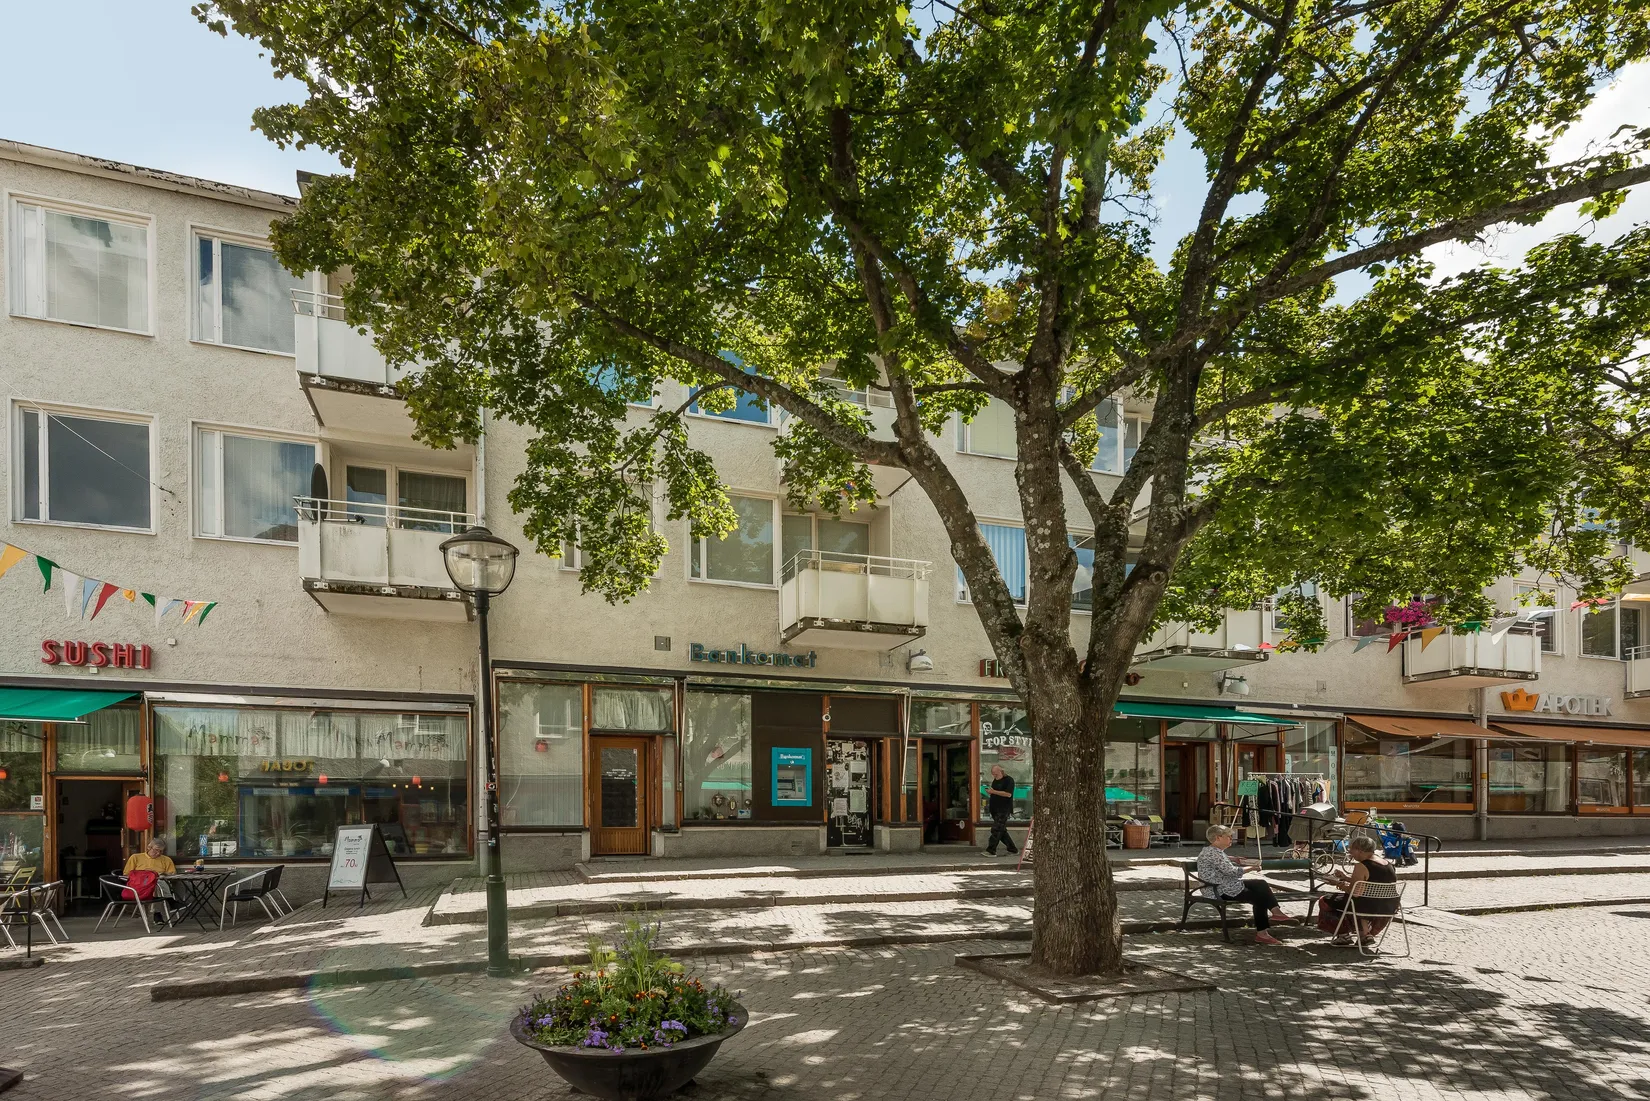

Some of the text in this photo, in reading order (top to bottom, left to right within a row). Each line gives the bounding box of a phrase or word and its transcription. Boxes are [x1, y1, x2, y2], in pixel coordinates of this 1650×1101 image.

[41, 640, 152, 669] SUSHI
[689, 642, 817, 668] Bankomat
[1534, 694, 1612, 716] APOTEK
[986, 735, 1007, 748] TOP
